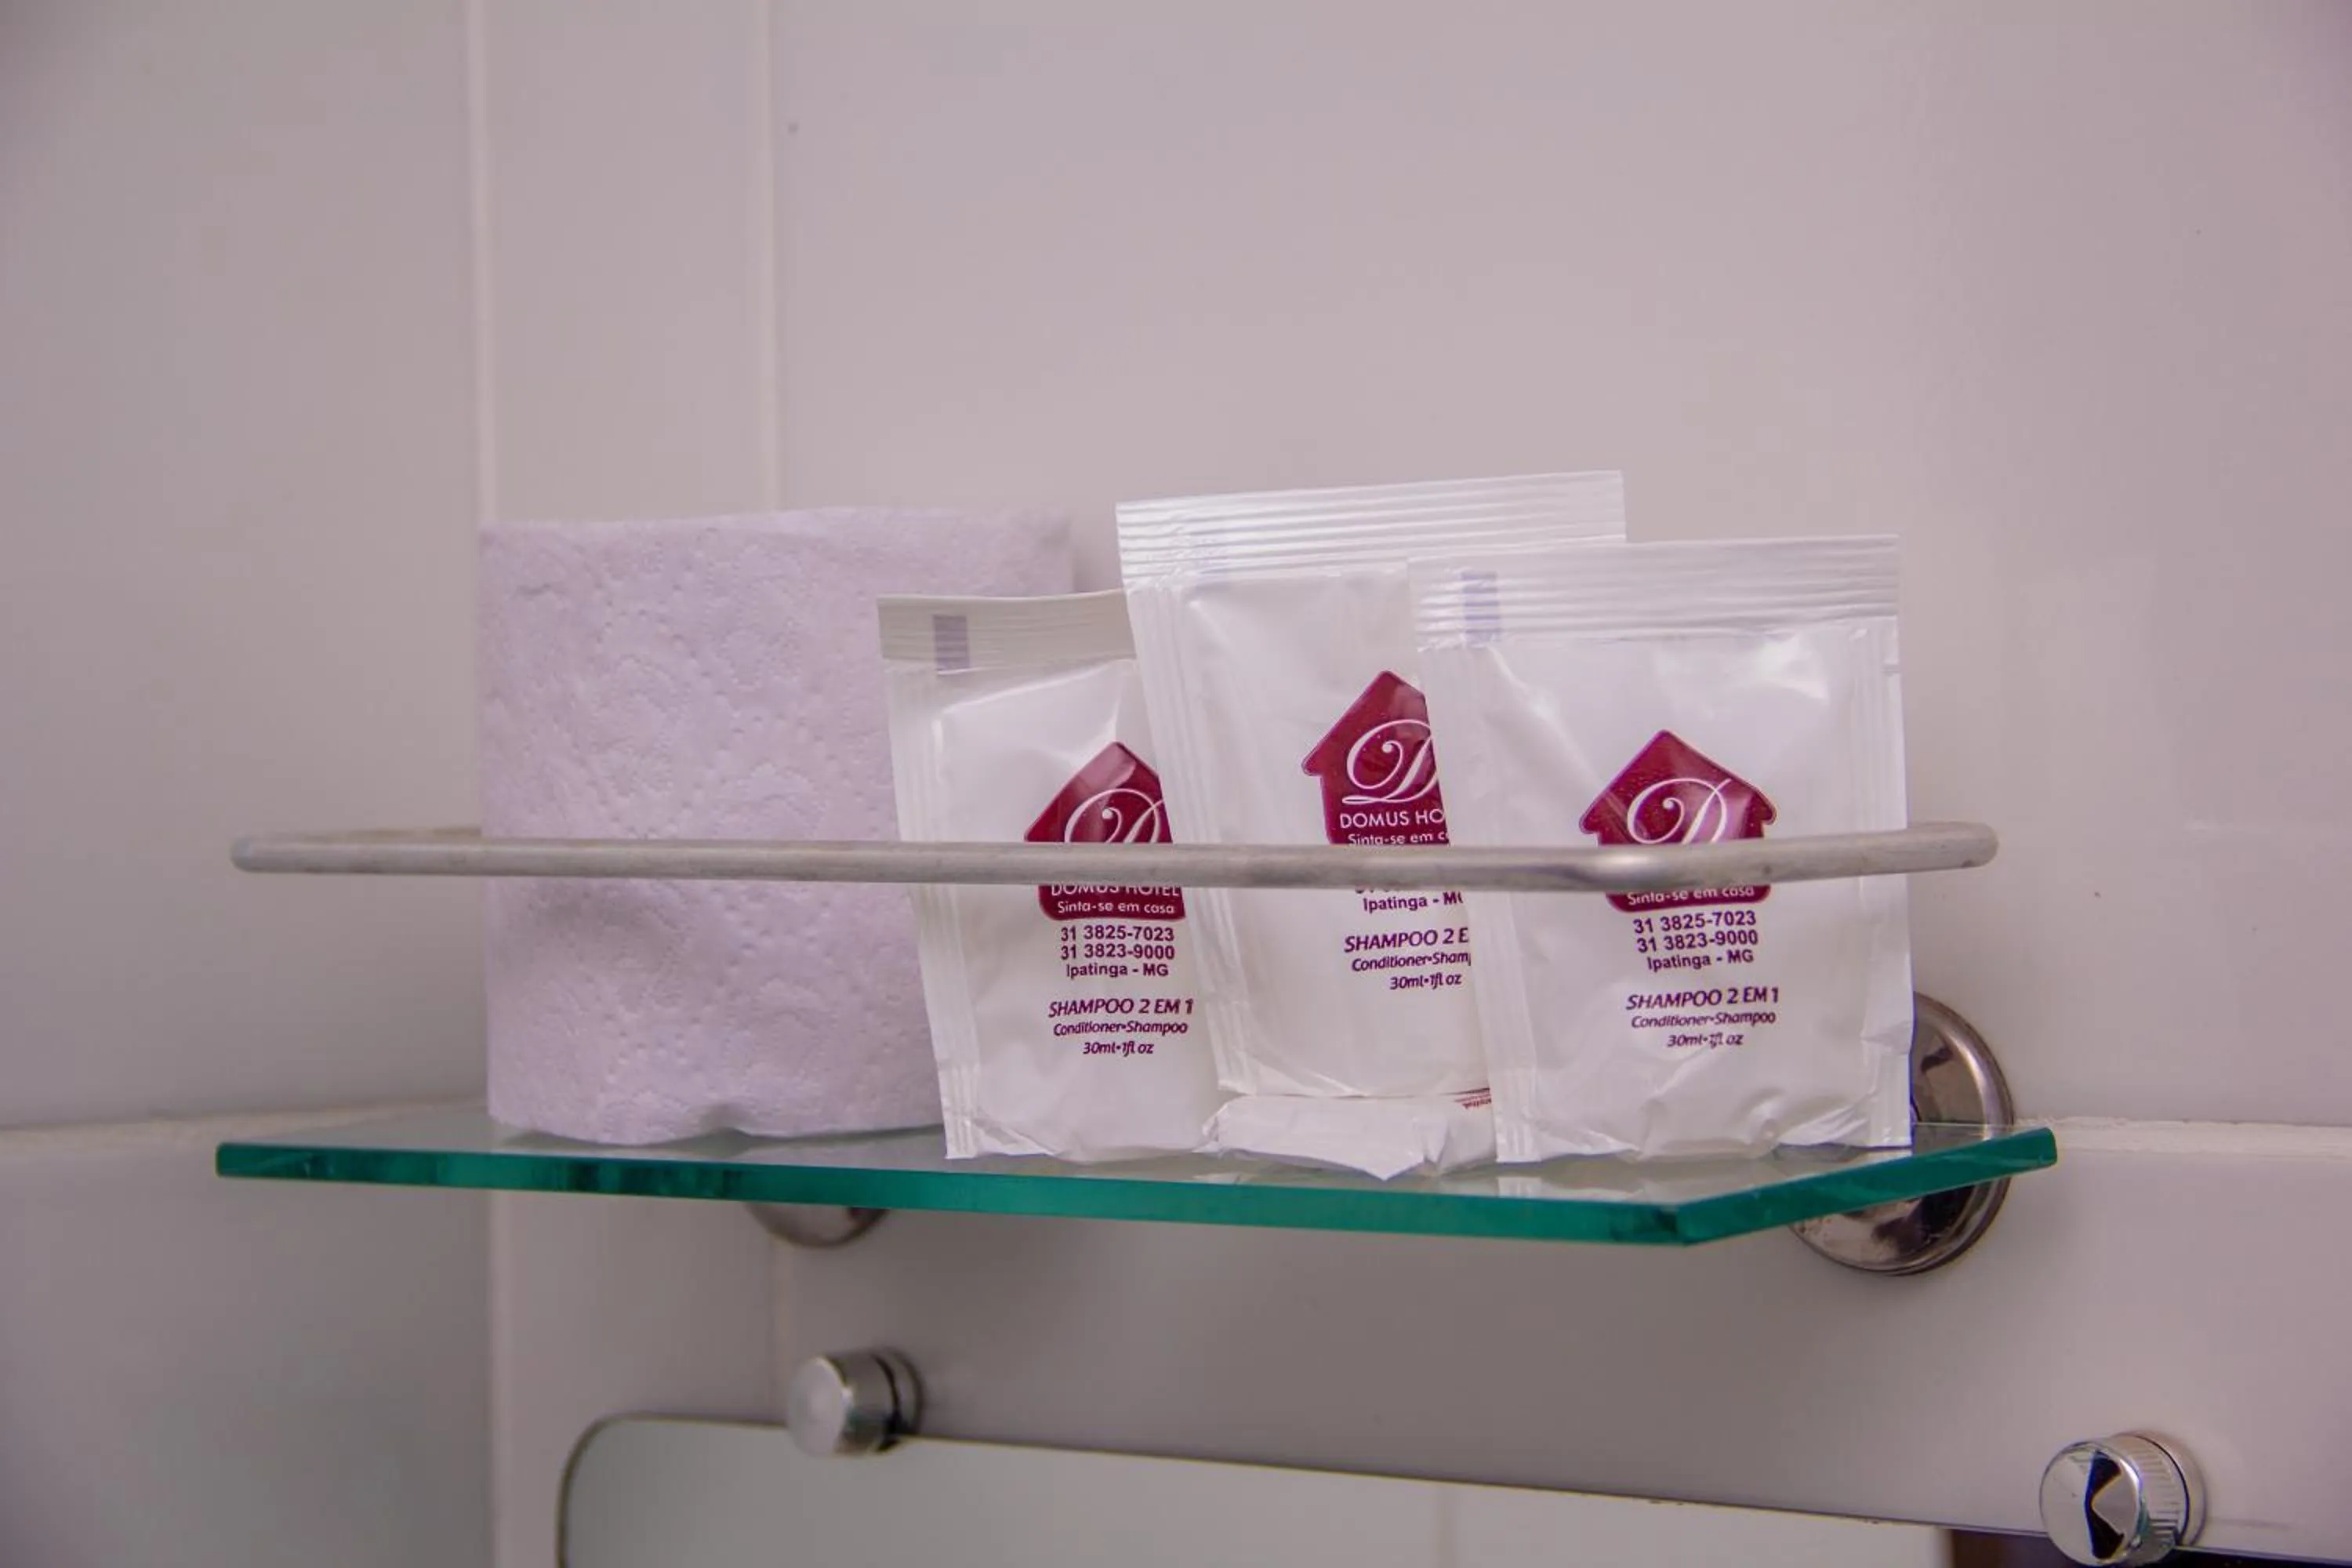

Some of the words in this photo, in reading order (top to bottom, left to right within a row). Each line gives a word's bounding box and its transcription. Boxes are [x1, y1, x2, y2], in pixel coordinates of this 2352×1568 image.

[1339, 811, 1410, 829] DOMUS
[1348, 833, 1406, 846] Sinta-se
[1410, 833, 1433, 843] em
[1051, 884, 1120, 896] DOMUS
[1125, 884, 1179, 897] HOTEL
[1627, 890, 1688, 906] Sinta-se
[1693, 887, 1718, 898] em
[1722, 886, 1755, 897] casa
[1058, 901, 1113, 913] Sinta-se
[1118, 903, 1140, 913] em
[1144, 903, 1174, 913] casa
[1363, 895, 1428, 914] Ipatinga
[1632, 918, 1654, 934] 31
[1660, 910, 1756, 931] 3825-7023
[1061, 927, 1076, 941] 31
[1083, 924, 1174, 942] 3825-7023
[1344, 929, 1439, 953] SHAMPOO
[1442, 927, 1454, 945] 2
[1637, 937, 1657, 953] 31
[1664, 929, 1759, 950] 3823-9000
[1061, 945, 1076, 960] 31
[1084, 943, 1174, 960] 3823-9000
[1647, 953, 1711, 973] Ipatinga
[1727, 949, 1755, 964] MG
[1066, 962, 1128, 979] Ipatinga
[1142, 963, 1169, 977] MG
[1446, 974, 1463, 985] oz
[1625, 989, 1722, 1010] SHAMPOO
[1726, 988, 1738, 1004] 2
[1743, 985, 1767, 1003] EM
[1771, 986, 1779, 1004] 1
[1048, 998, 1134, 1018] SHAMPOO
[1138, 998, 1150, 1014] 2
[1154, 998, 1181, 1014] EM
[1185, 998, 1194, 1014] 1
[1726, 1034, 1744, 1045] oz
[1138, 1044, 1155, 1054] oz
